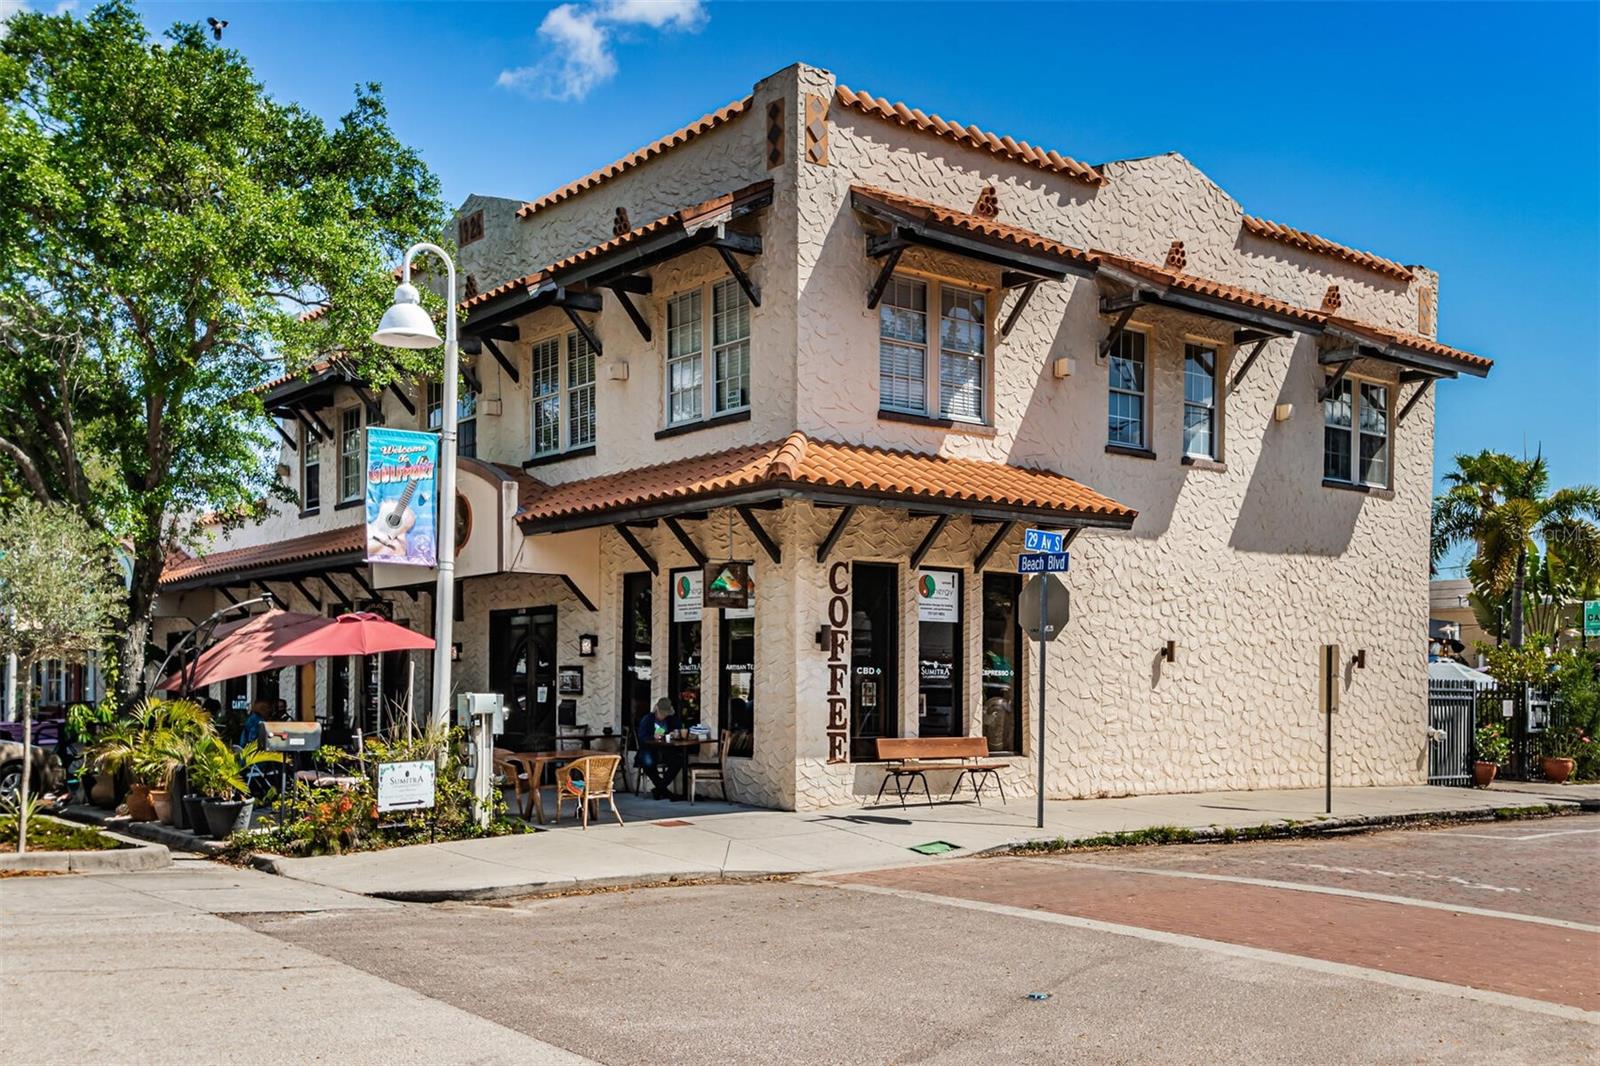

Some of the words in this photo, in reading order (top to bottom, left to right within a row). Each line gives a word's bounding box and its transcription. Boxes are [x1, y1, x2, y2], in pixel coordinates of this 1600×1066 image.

[380, 445, 427, 455] Welcome
[1027, 532, 1038, 548] 29
[1042, 534, 1052, 550] Av
[1055, 536, 1061, 551] S
[1021, 556, 1044, 571] Beach
[1047, 555, 1066, 571] Blvd
[826, 562, 849, 764] COFFEE
[856, 667, 875, 675] CBD
[921, 666, 950, 675] SUMITRA
[389, 775, 424, 785] SUMITRA
